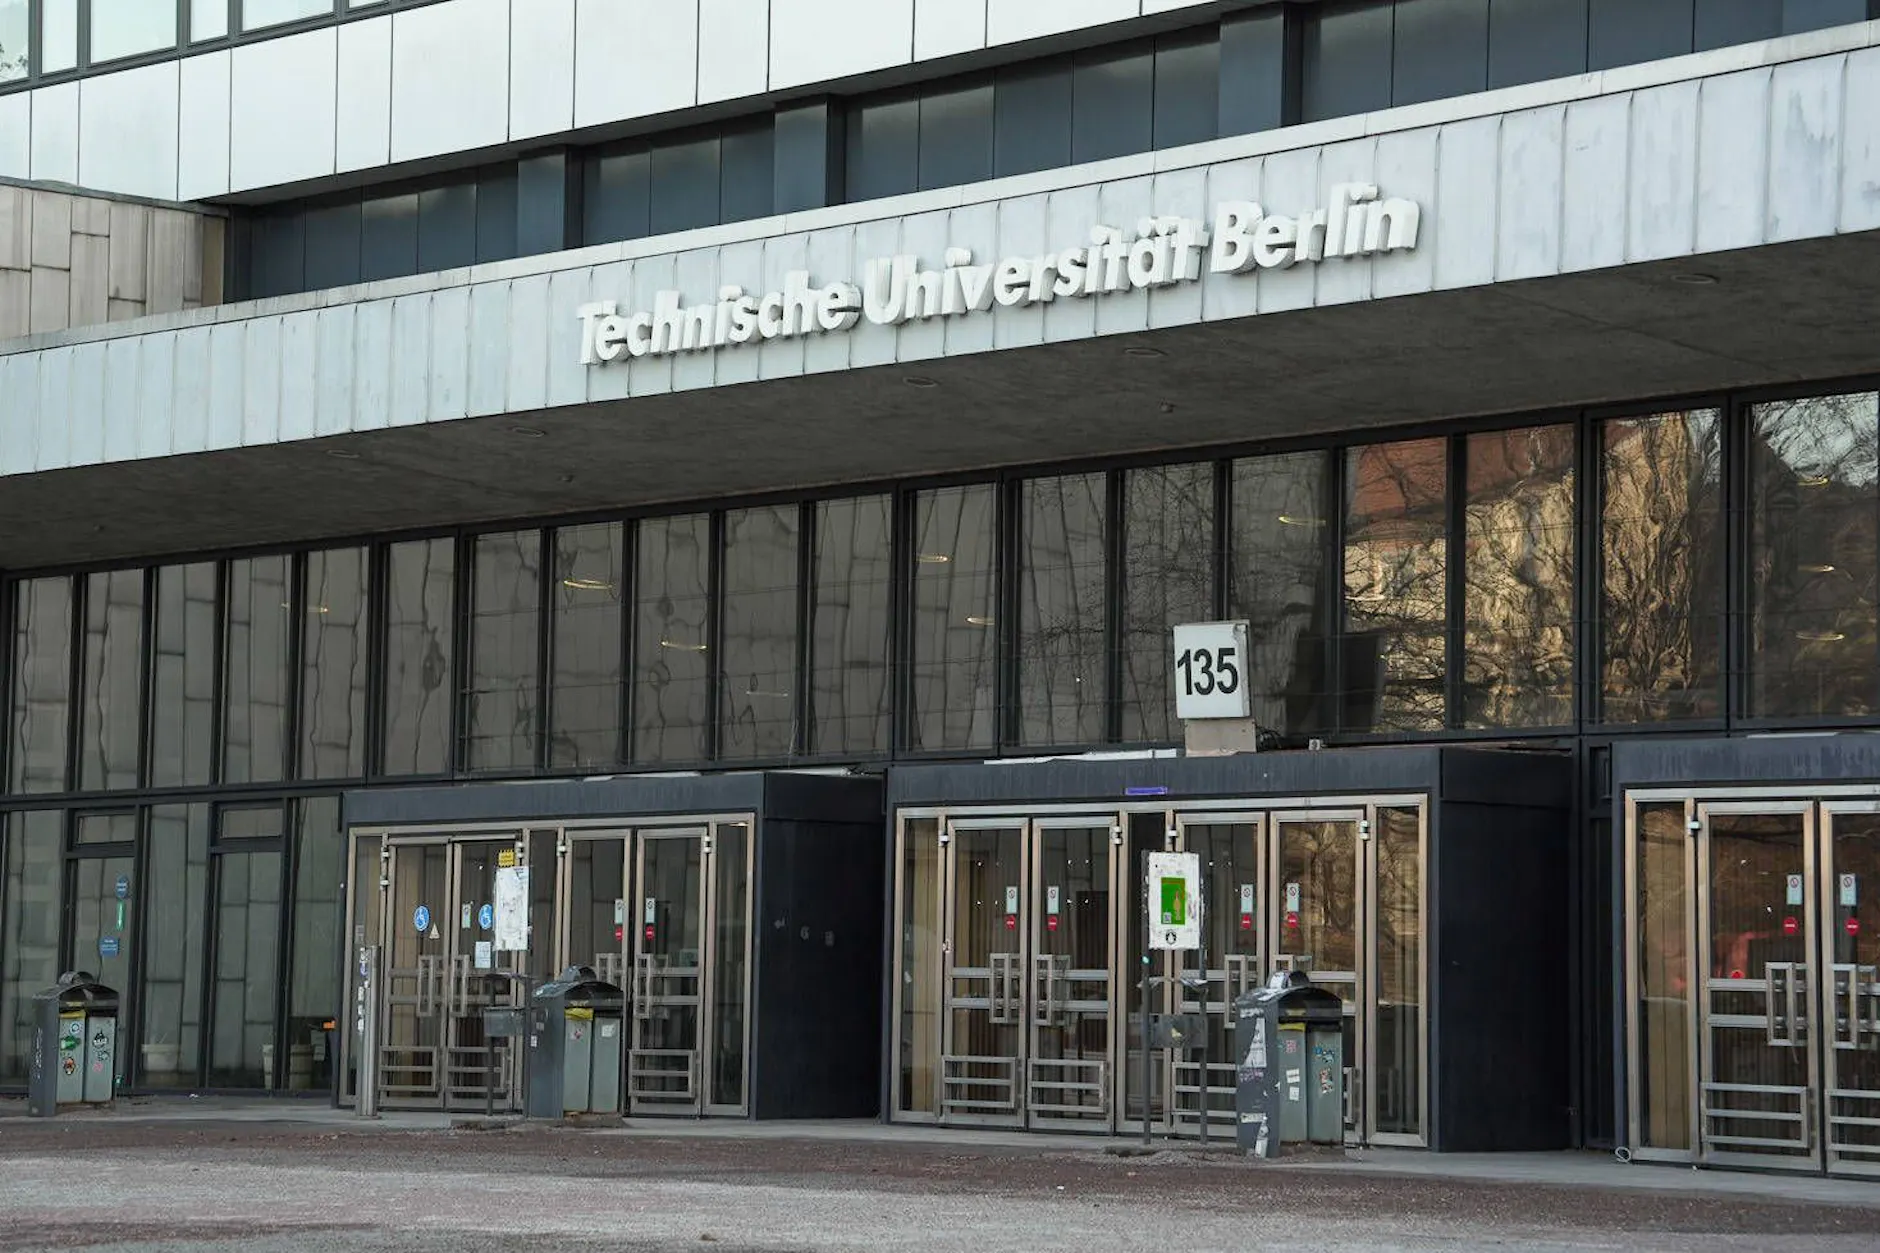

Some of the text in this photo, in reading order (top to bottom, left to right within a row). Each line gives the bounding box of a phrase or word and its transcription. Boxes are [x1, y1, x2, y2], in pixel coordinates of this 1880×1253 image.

[577, 182, 1421, 365] Technische Universität Berlin
[1177, 648, 1239, 695] 135
